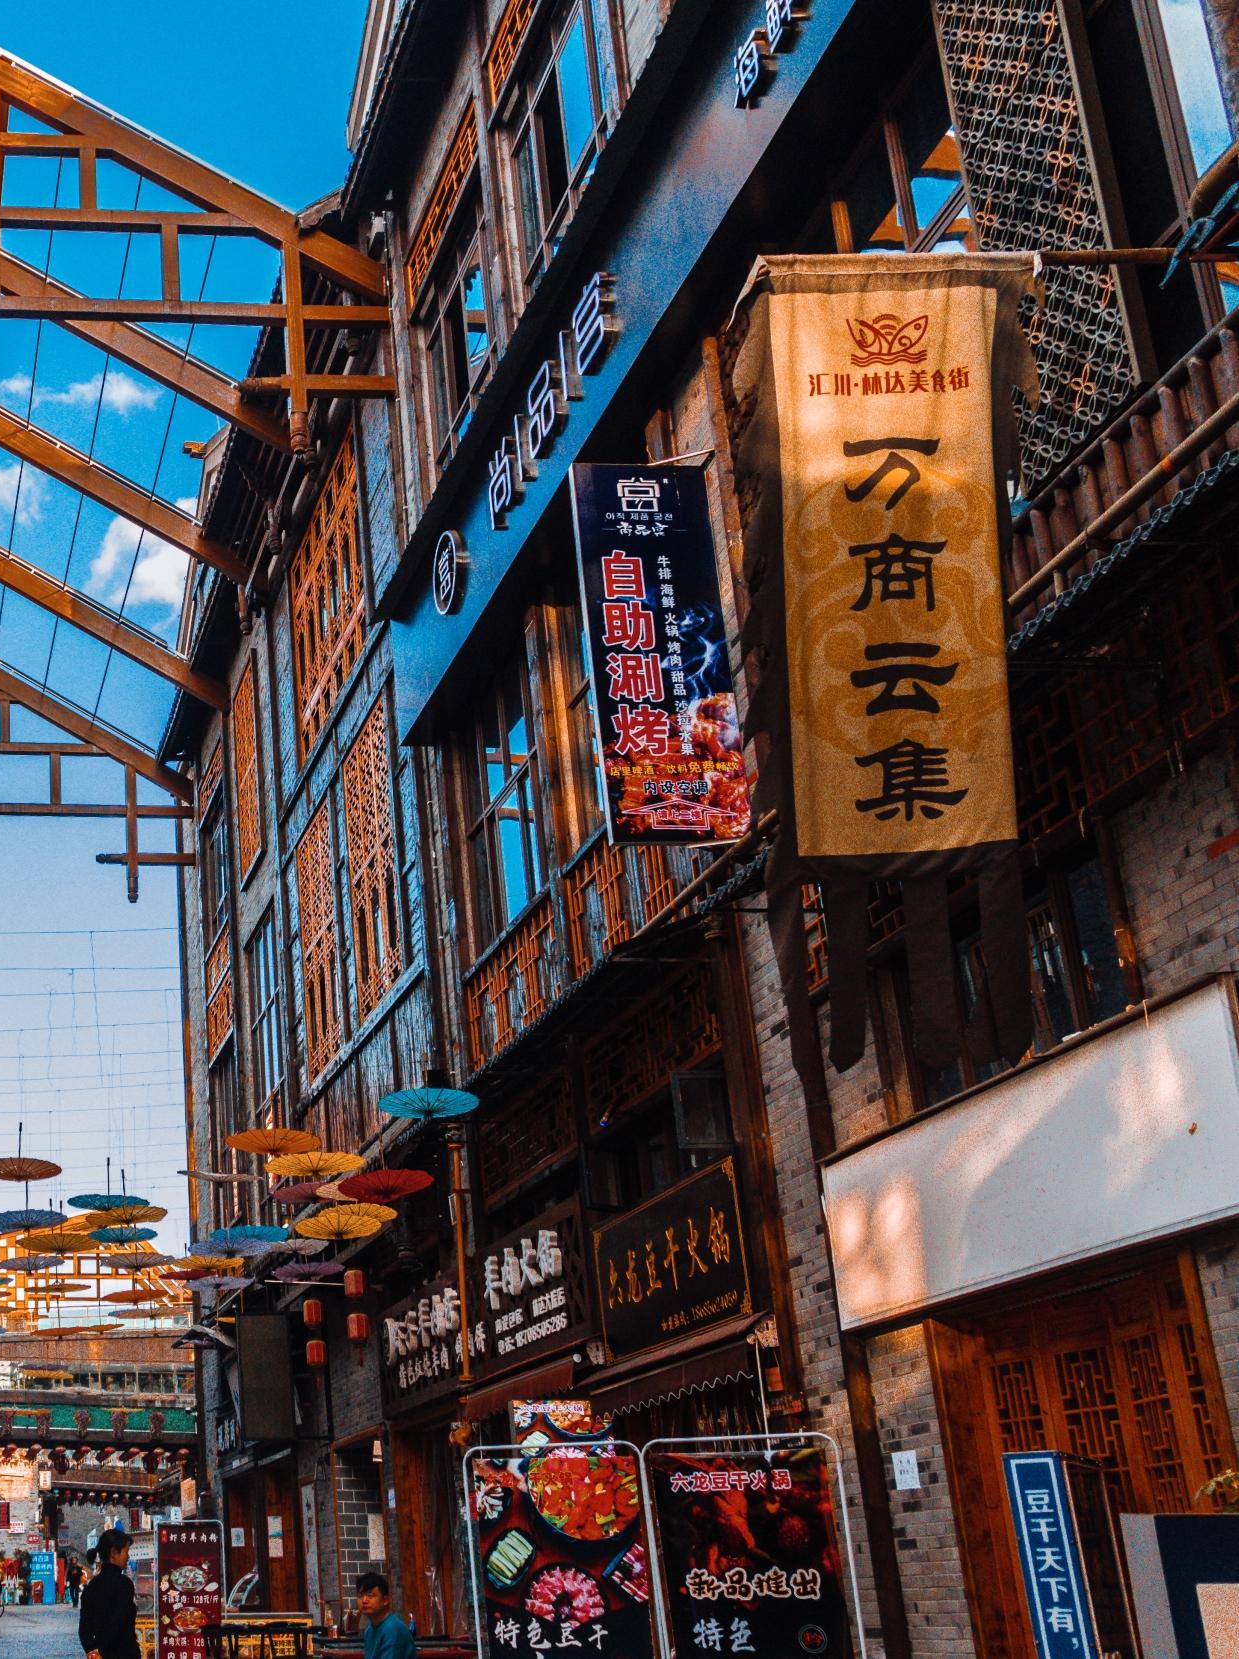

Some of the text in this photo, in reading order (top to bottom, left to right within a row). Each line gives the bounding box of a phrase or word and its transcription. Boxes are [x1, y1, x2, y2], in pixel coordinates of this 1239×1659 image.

[808, 365, 971, 398] 汇川·林达美食街
[843, 436, 969, 822] 万商云集
[601, 549, 671, 757] 自助涮烤
[657, 555, 695, 756] 牛排 海鲜 火锅 烤肉 甜品 沙拉 水果
[643, 780, 709, 795] 内设空调
[670, 1469, 792, 1493] 六龙豆干火锅
[686, 1565, 821, 1600] 新品推出
[494, 1617, 608, 1650] 特色豆干
[693, 1617, 756, 1653] 特色
